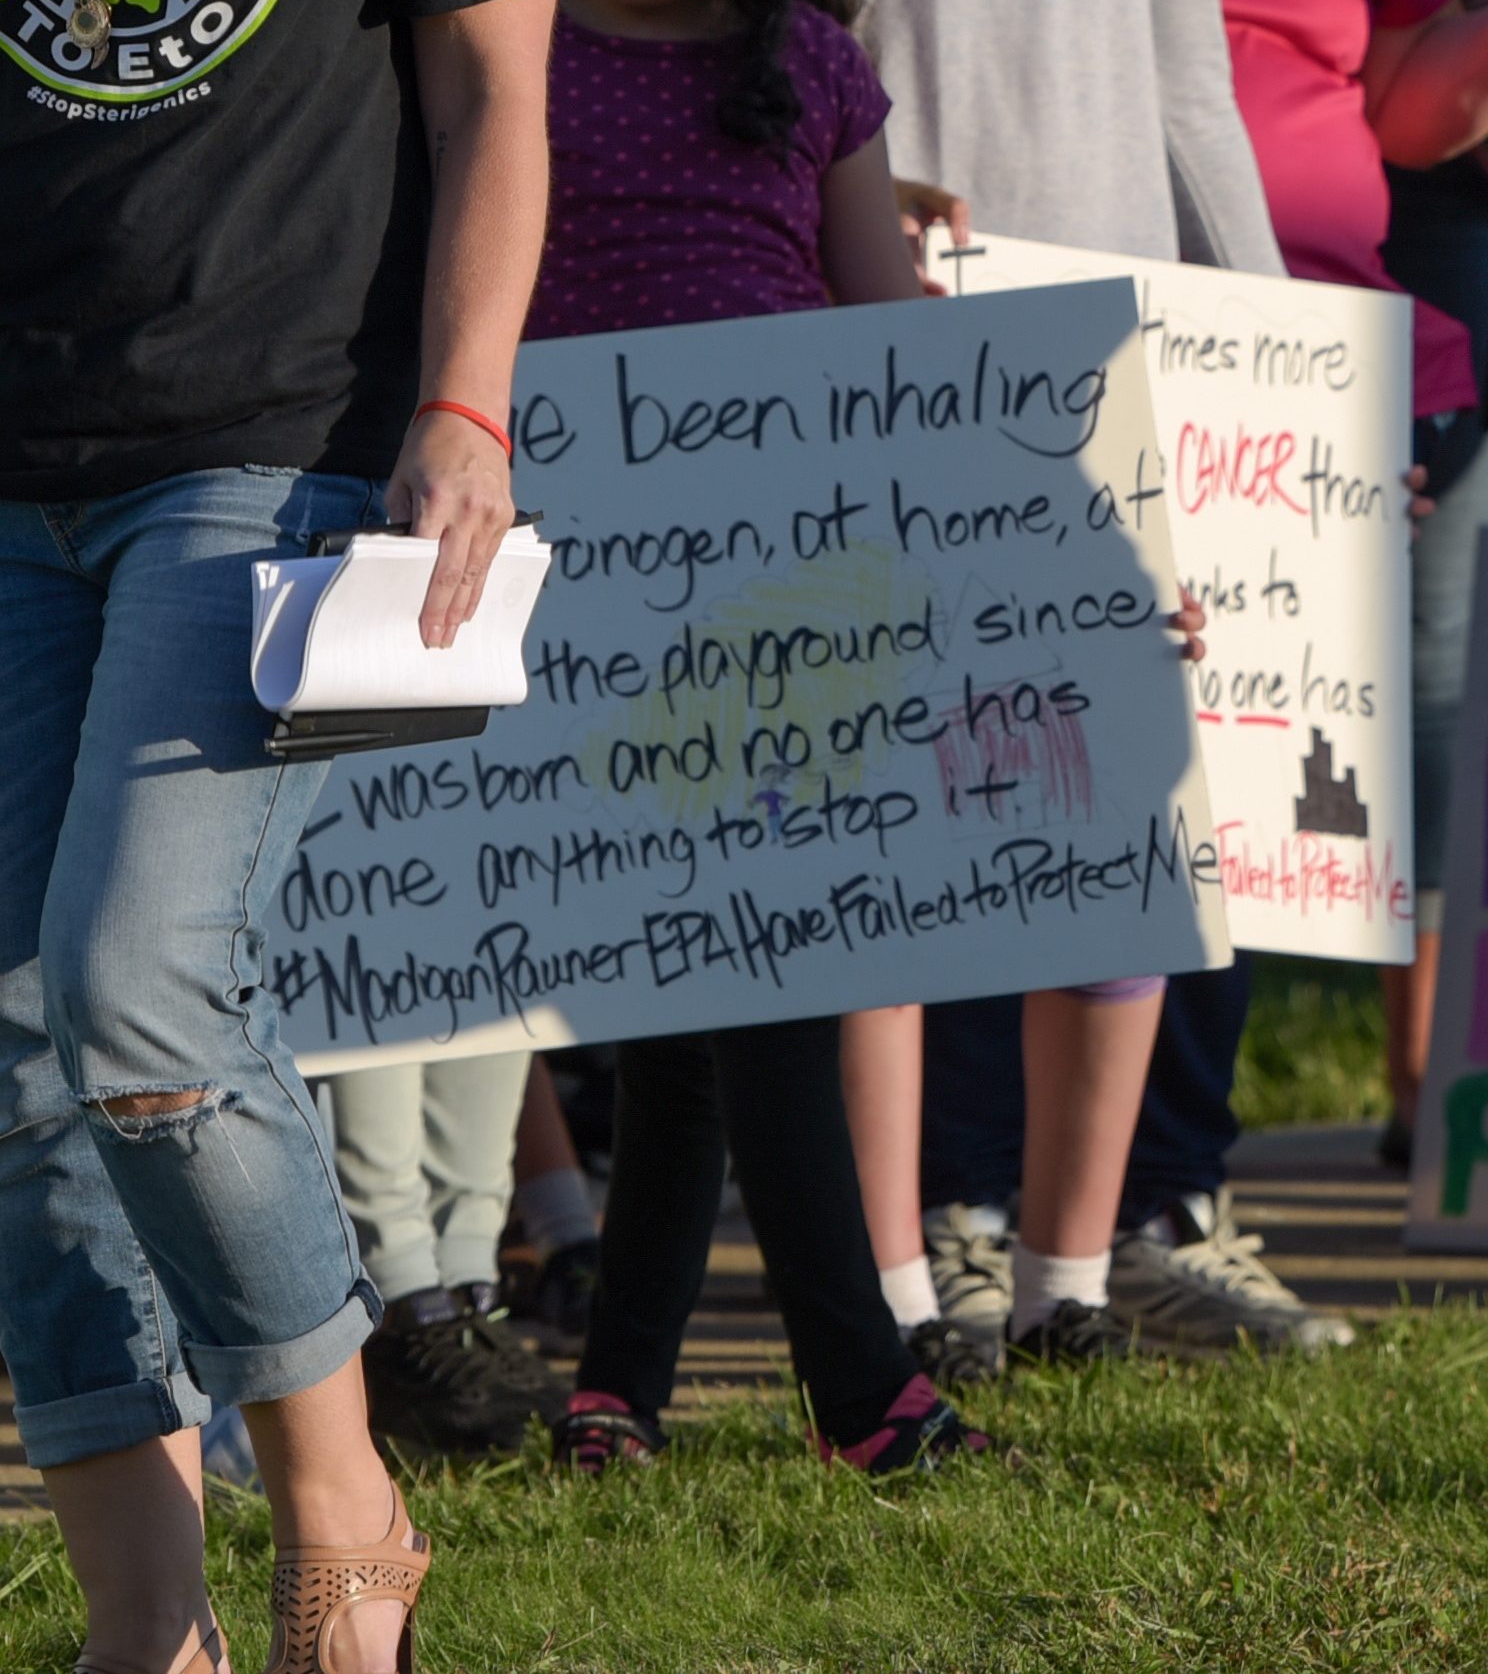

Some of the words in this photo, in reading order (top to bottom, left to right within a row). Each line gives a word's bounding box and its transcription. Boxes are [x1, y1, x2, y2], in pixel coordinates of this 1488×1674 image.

[17, 0, 95, 72] TO
[117, 1, 234, 81] EtO
[26, 81, 212, 123] #StopSterigenics
[616, 352, 805, 466] been
[828, 341, 1109, 458] inhaling
[1254, 332, 1358, 391] more
[792, 483, 869, 561] at
[892, 479, 1068, 552] home,
[1087, 448, 1164, 530] at
[1176, 421, 1310, 516] CANCER
[1302, 435, 1390, 539] than
[1261, 547, 1302, 621] to
[531, 639, 649, 705] the
[661, 597, 946, 715] playground
[974, 590, 1156, 645] since
[1231, 671, 1289, 710] one
[1302, 641, 1375, 718] has
[350, 759, 468, 830] was
[472, 749, 588, 812] born
[608, 722, 725, 794] and
[743, 726, 811, 777] no
[828, 695, 949, 756] one
[964, 673, 1091, 741] has
[281, 849, 449, 933] done
[477, 825, 697, 910] anything
[706, 806, 765, 862] to
[782, 775, 918, 858] stop
